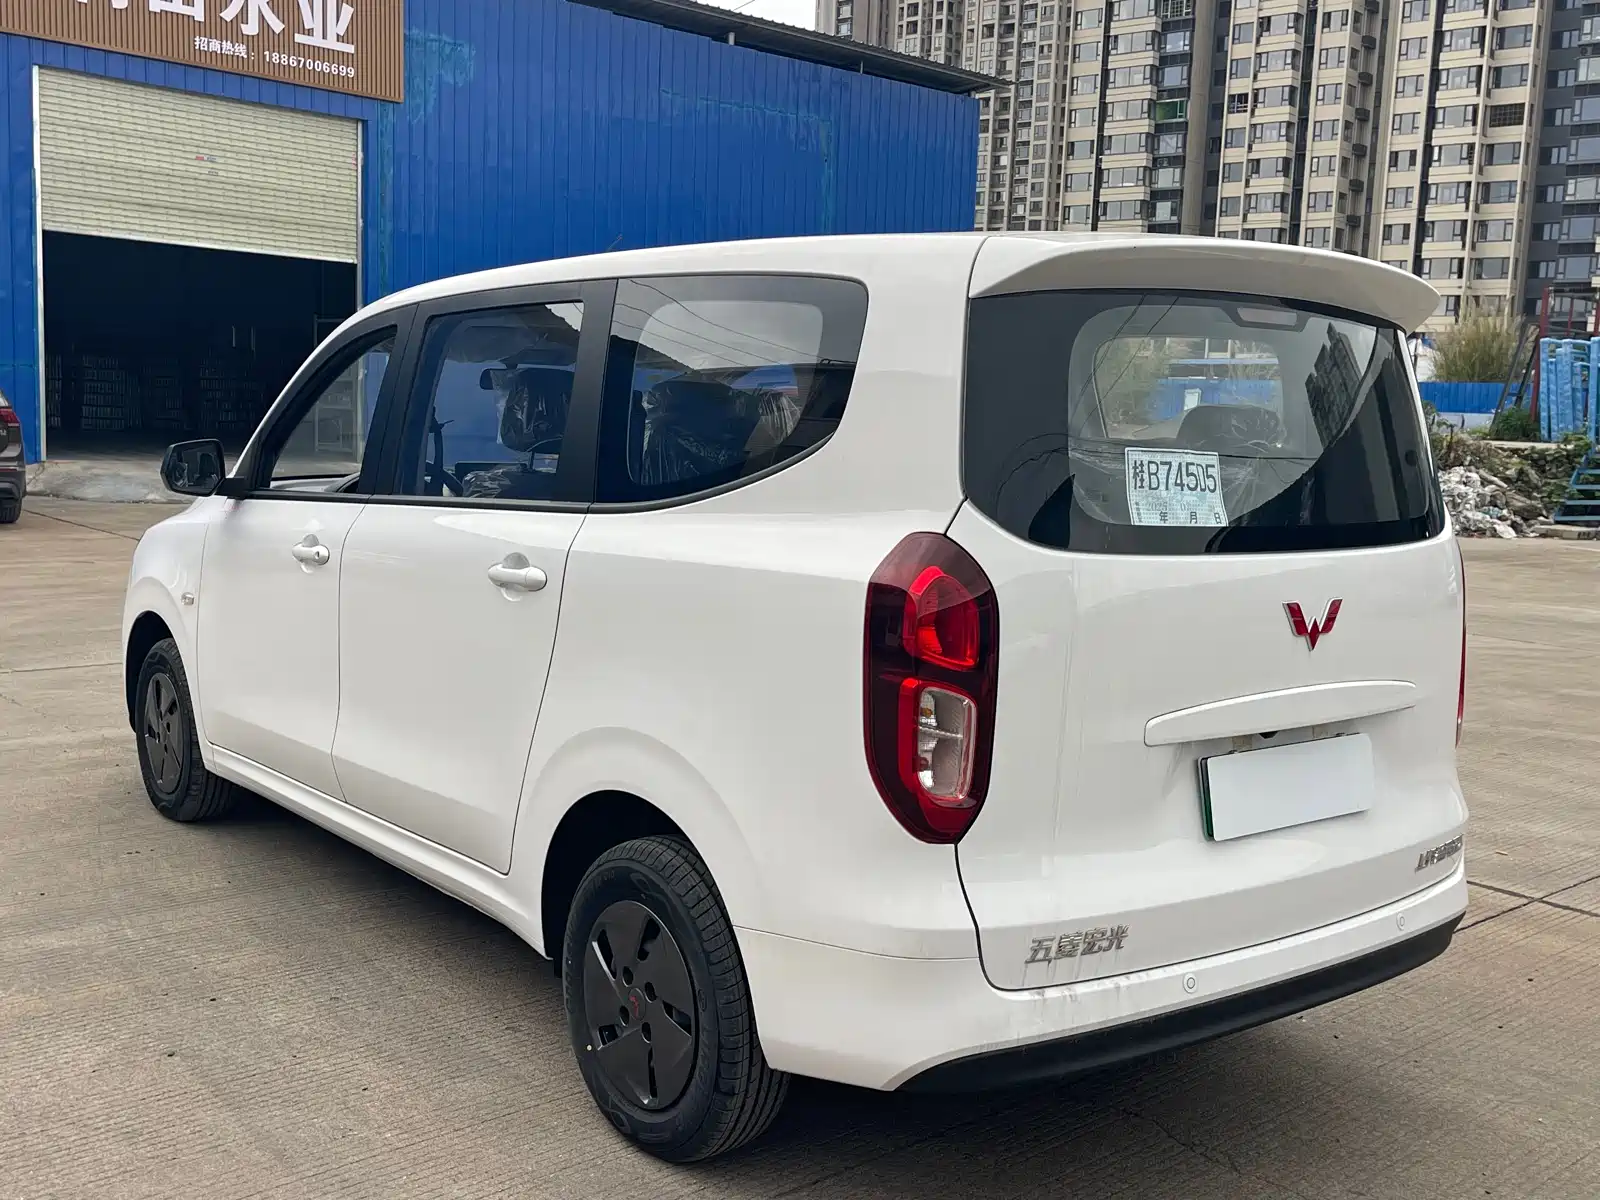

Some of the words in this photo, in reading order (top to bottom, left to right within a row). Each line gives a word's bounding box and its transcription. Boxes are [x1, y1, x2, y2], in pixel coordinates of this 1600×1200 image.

[263, 50, 355, 78] 18867006699
[1159, 511, 1169, 524] 年
[1189, 511, 1198, 524] 月
